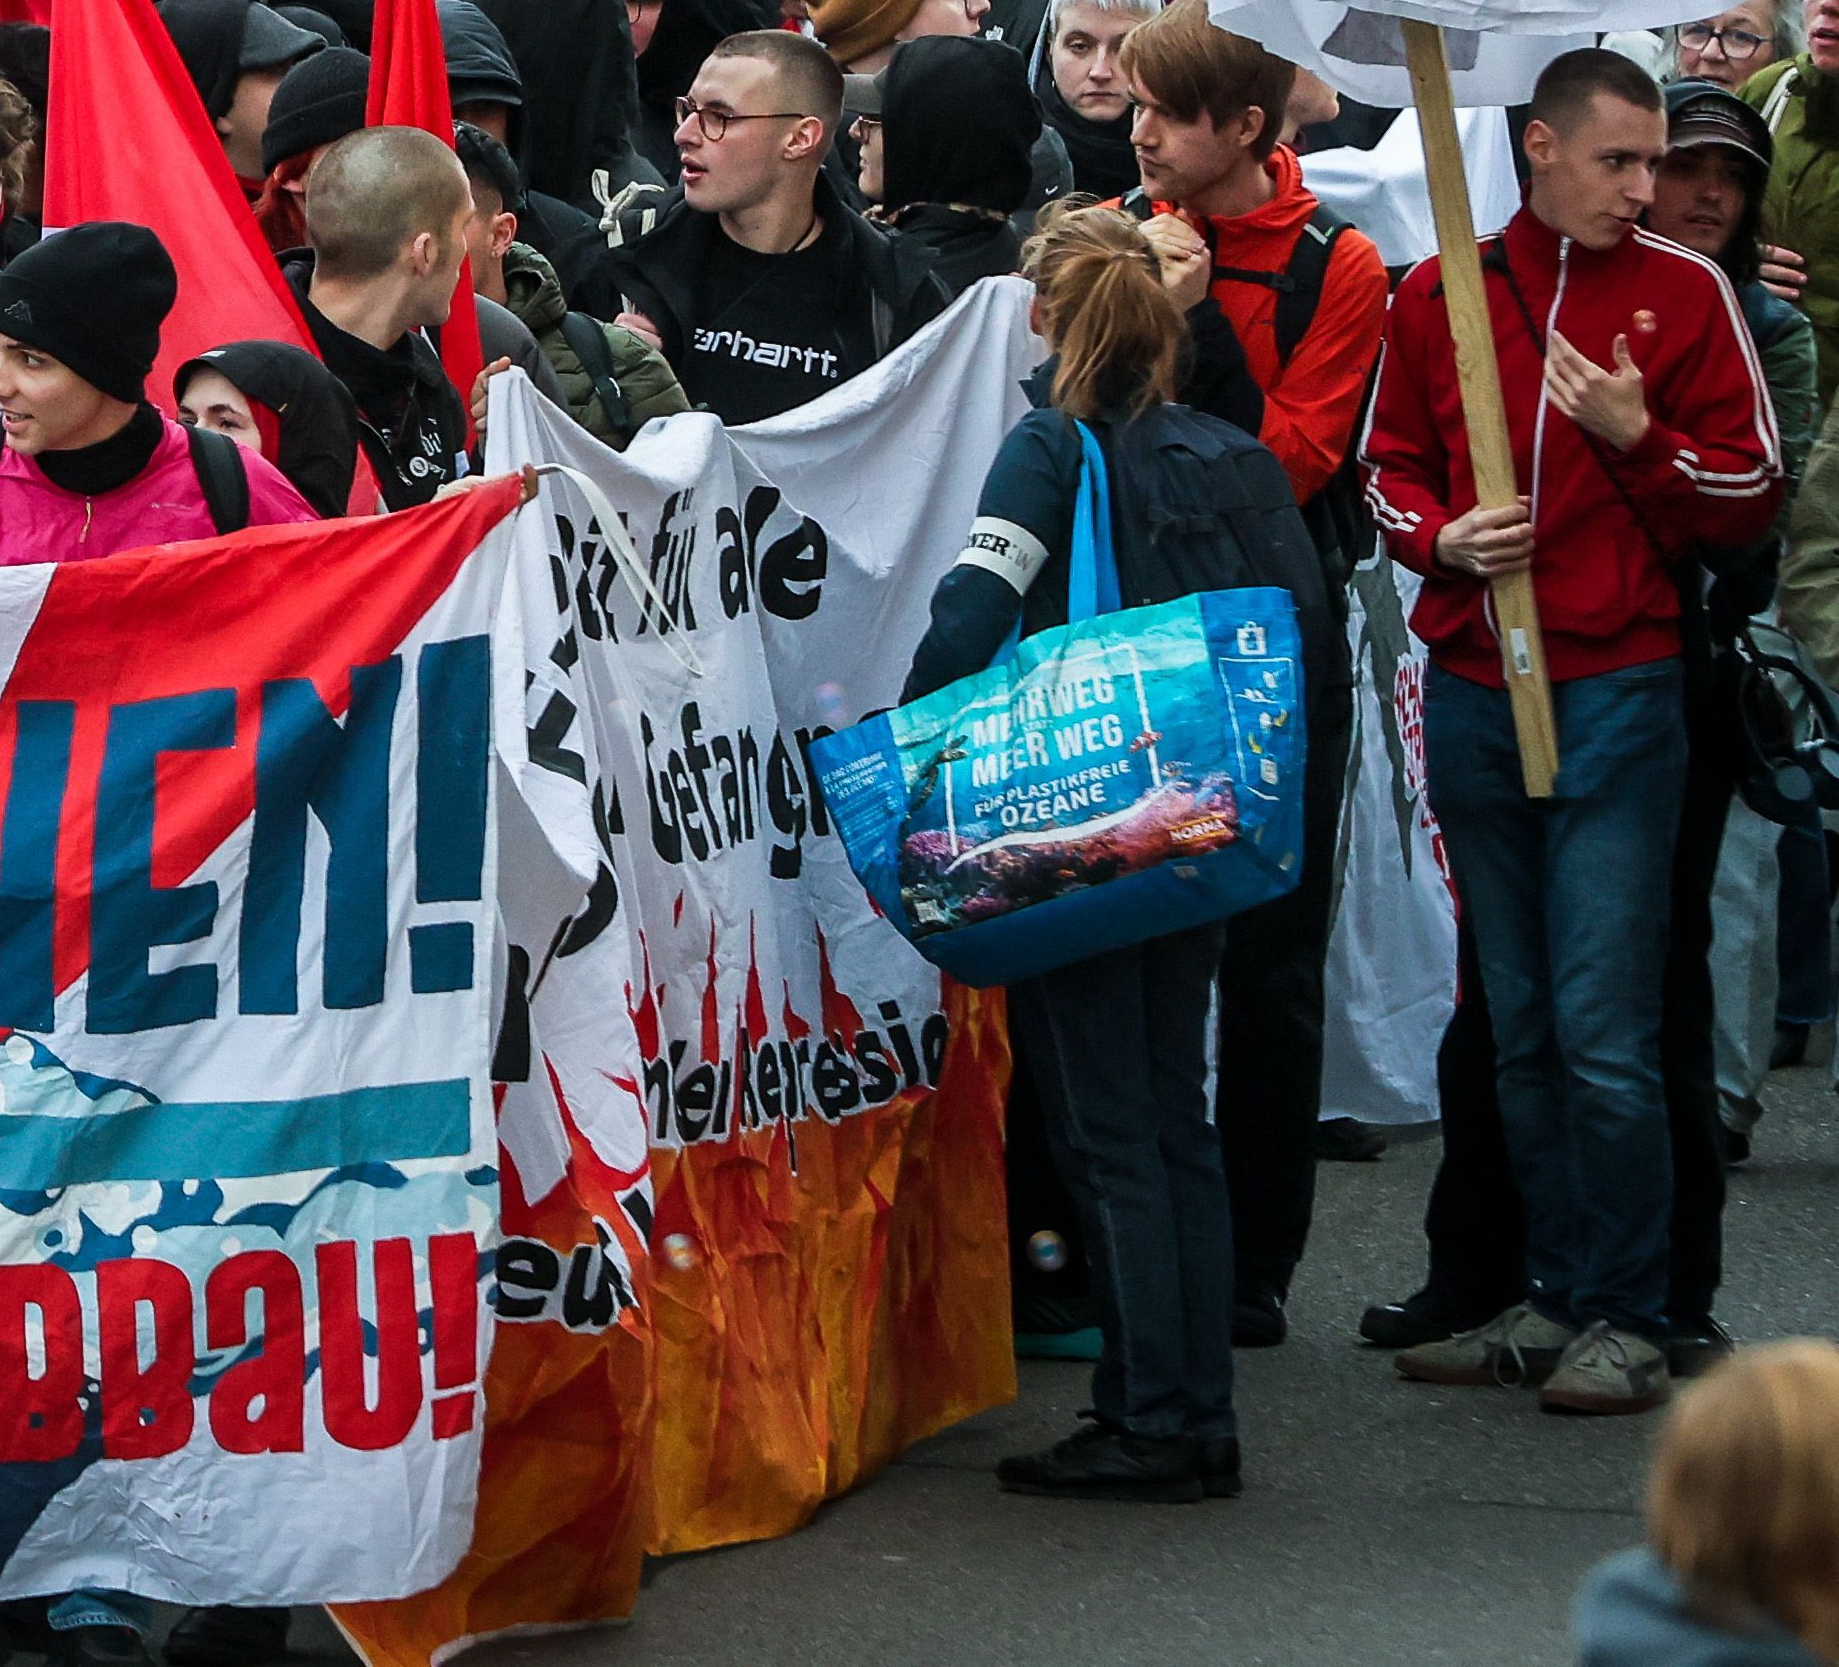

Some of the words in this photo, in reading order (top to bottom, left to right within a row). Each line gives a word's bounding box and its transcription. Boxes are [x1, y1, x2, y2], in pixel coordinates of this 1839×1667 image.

[693, 327, 833, 379] arhartt
[1053, 713, 1124, 762] WEG
[1006, 759, 1132, 803] PLASTIKFREIE
[999, 782, 1107, 828] OZEANE
